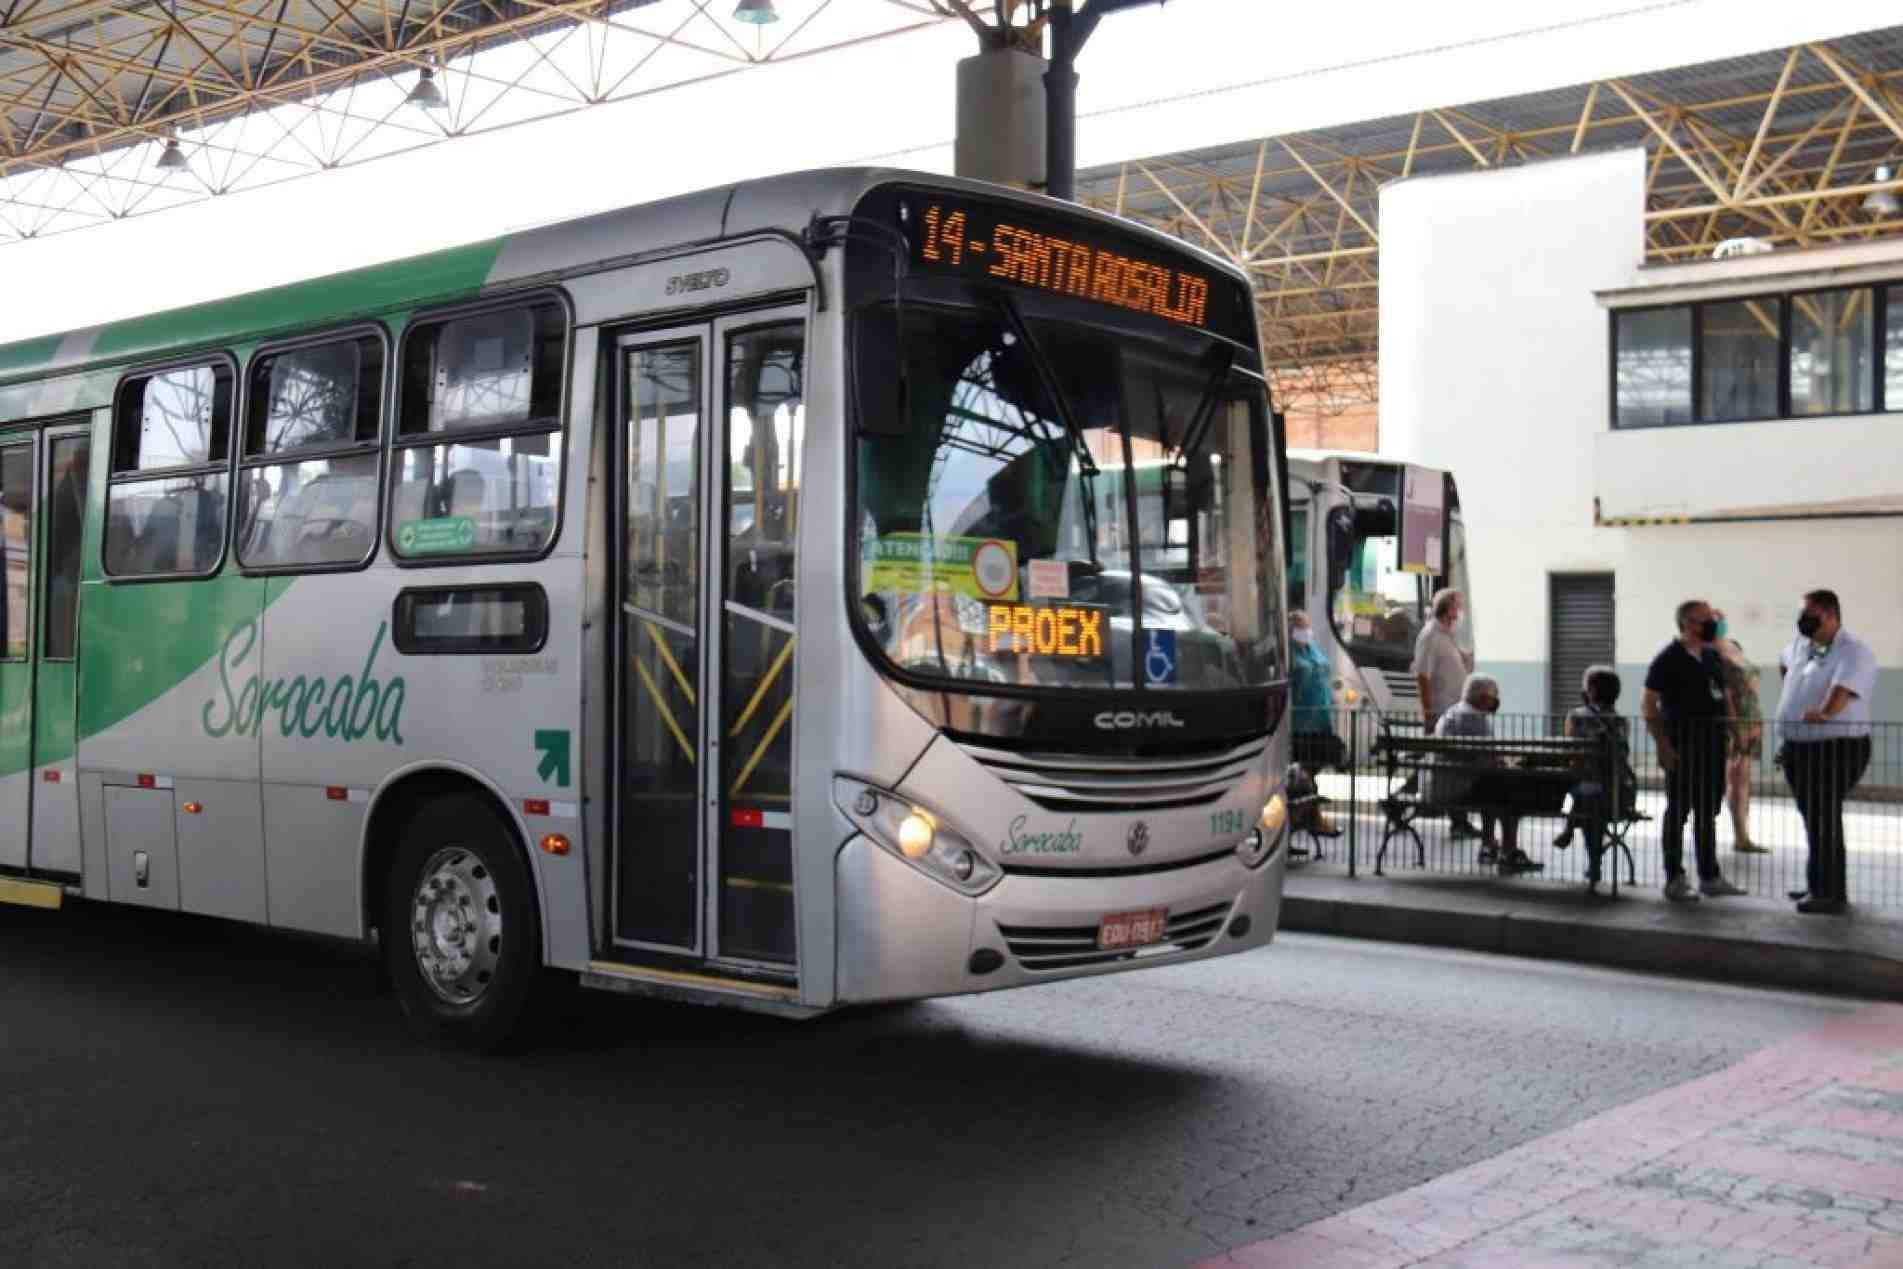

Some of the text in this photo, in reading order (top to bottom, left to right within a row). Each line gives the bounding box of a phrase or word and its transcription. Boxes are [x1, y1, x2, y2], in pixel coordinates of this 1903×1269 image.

[921, 204, 966, 265] 14
[988, 604, 1101, 656] PROEX
[203, 620, 406, 745] Sorocaba
[1093, 711, 1185, 730] COMIL
[1000, 814, 1084, 855] Sorocaba
